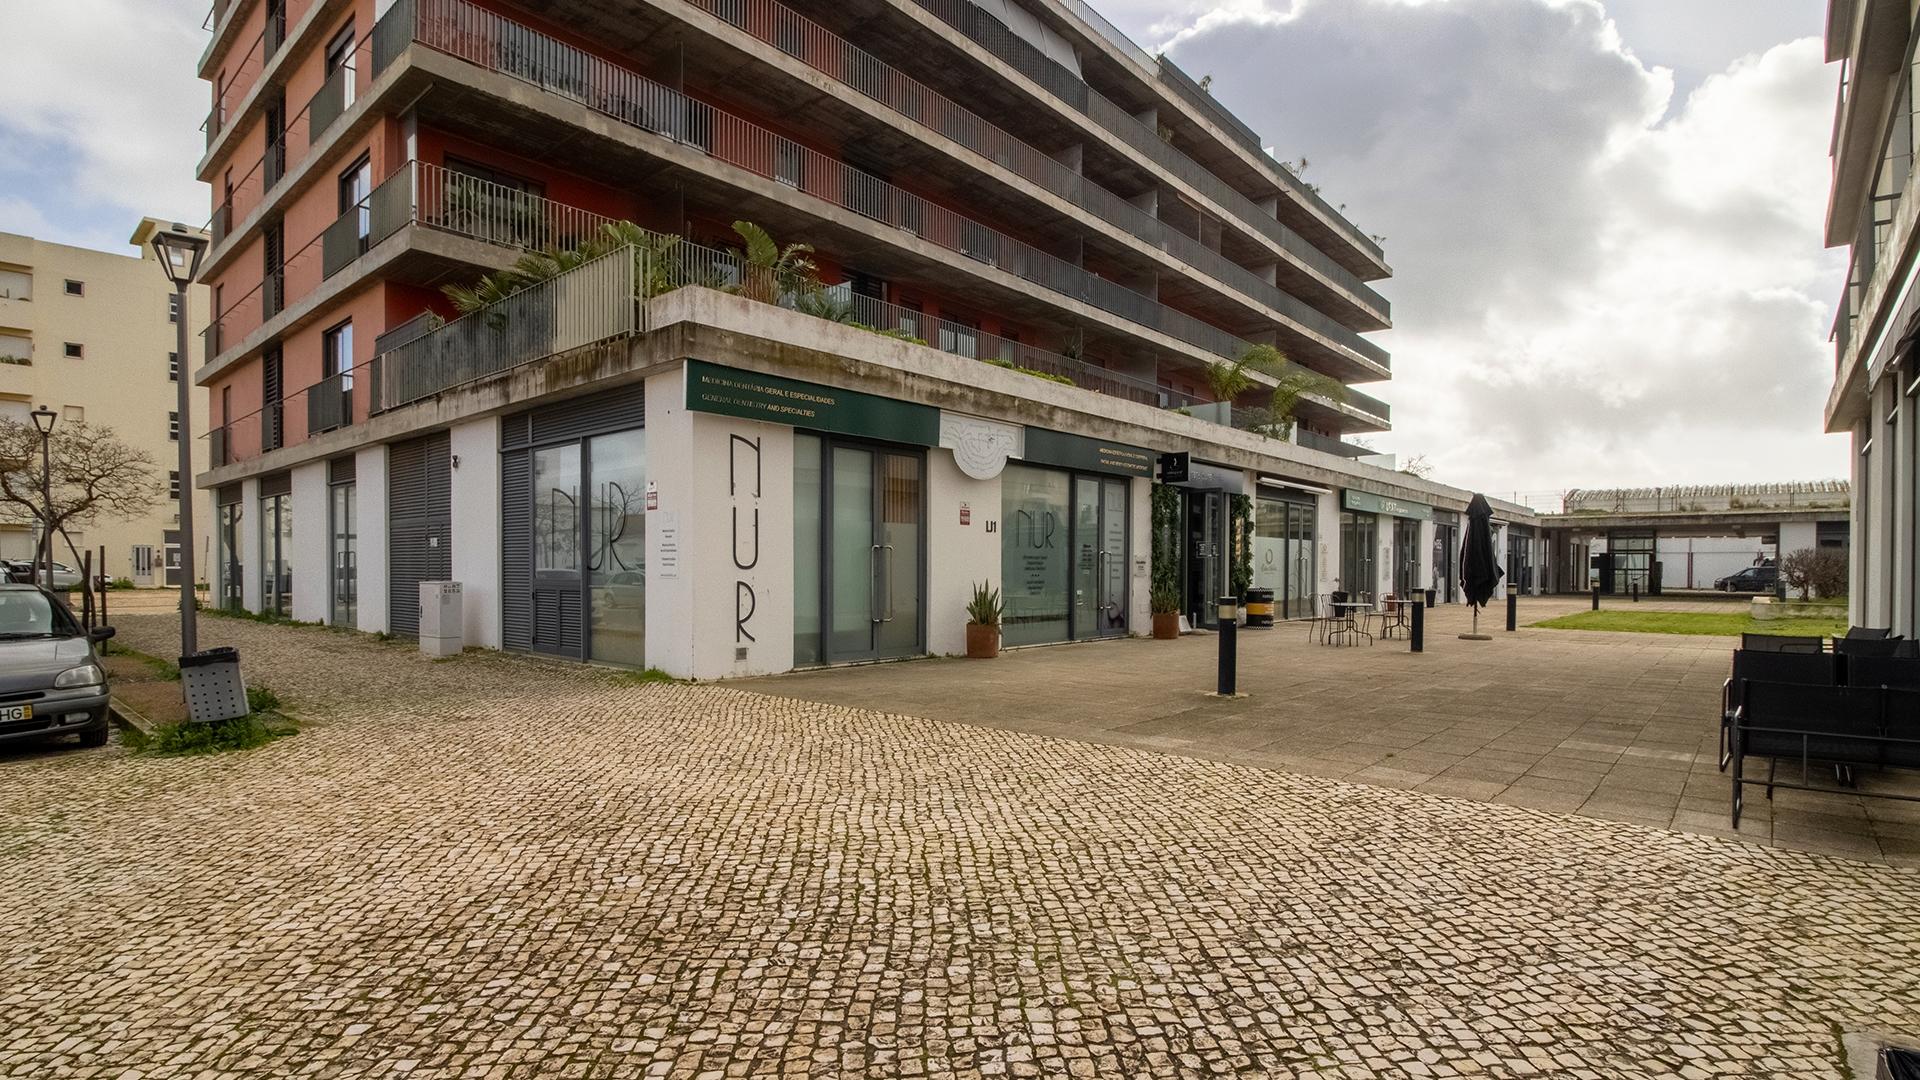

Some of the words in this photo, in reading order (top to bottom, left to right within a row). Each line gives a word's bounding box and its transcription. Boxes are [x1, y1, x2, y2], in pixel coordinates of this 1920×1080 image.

[701, 375, 733, 387] MEDICINA
[764, 387, 785, 397] GERAL
[790, 391, 836, 405] ESPECIALIDADES
[701, 394, 732, 404] GENERAL
[767, 404, 780, 413] AND
[780, 405, 816, 417] SPECIALTIES
[730, 433, 761, 643] NUR
[985, 520, 997, 533] U1
[1016, 509, 1055, 549] NUR
